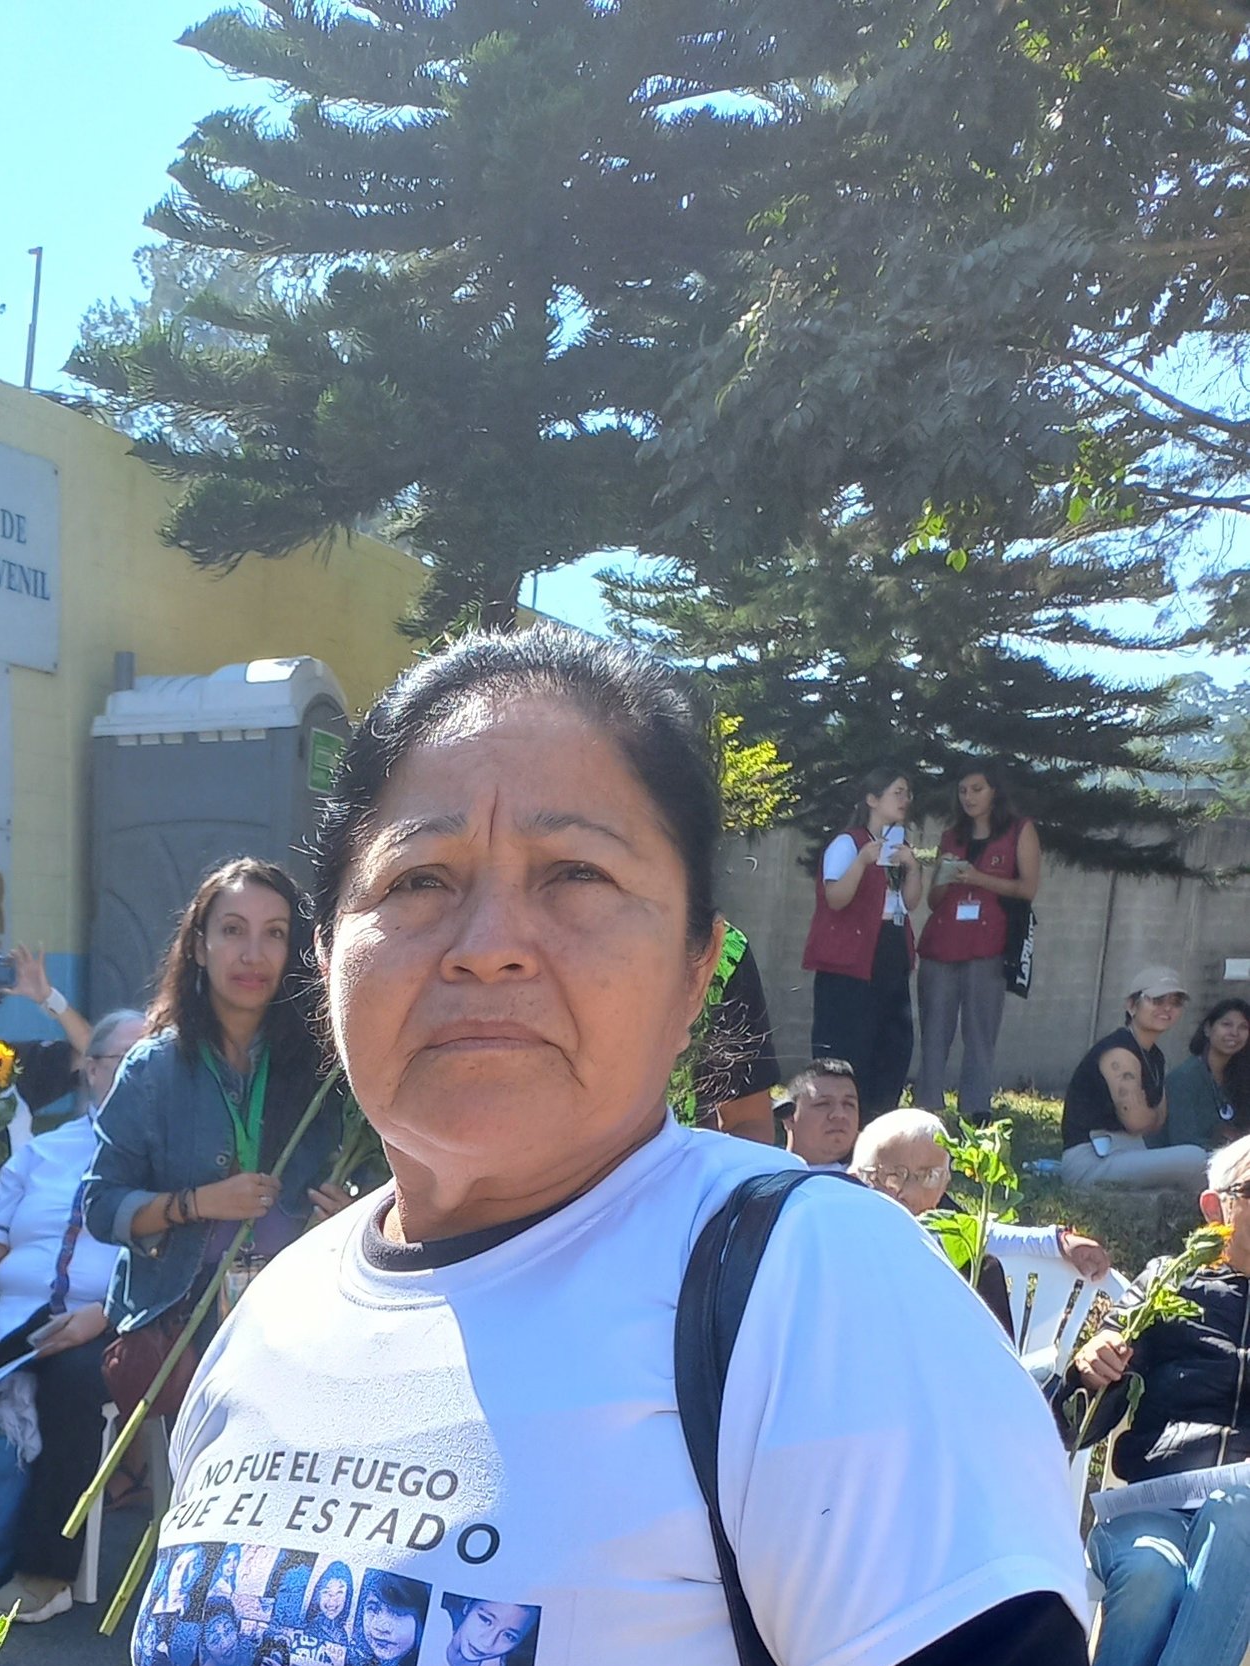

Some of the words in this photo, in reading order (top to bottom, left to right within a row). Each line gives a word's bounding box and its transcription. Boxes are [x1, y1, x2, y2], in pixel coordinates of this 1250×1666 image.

[0, 508, 27, 544] DE
[200, 1459, 233, 1491] NO
[233, 1451, 285, 1484] FUE
[288, 1451, 321, 1483] EL
[330, 1455, 459, 1501] FUEGO
[164, 1495, 220, 1532] FUE
[223, 1493, 268, 1527] EL
[285, 1495, 501, 1565] ESTADO
